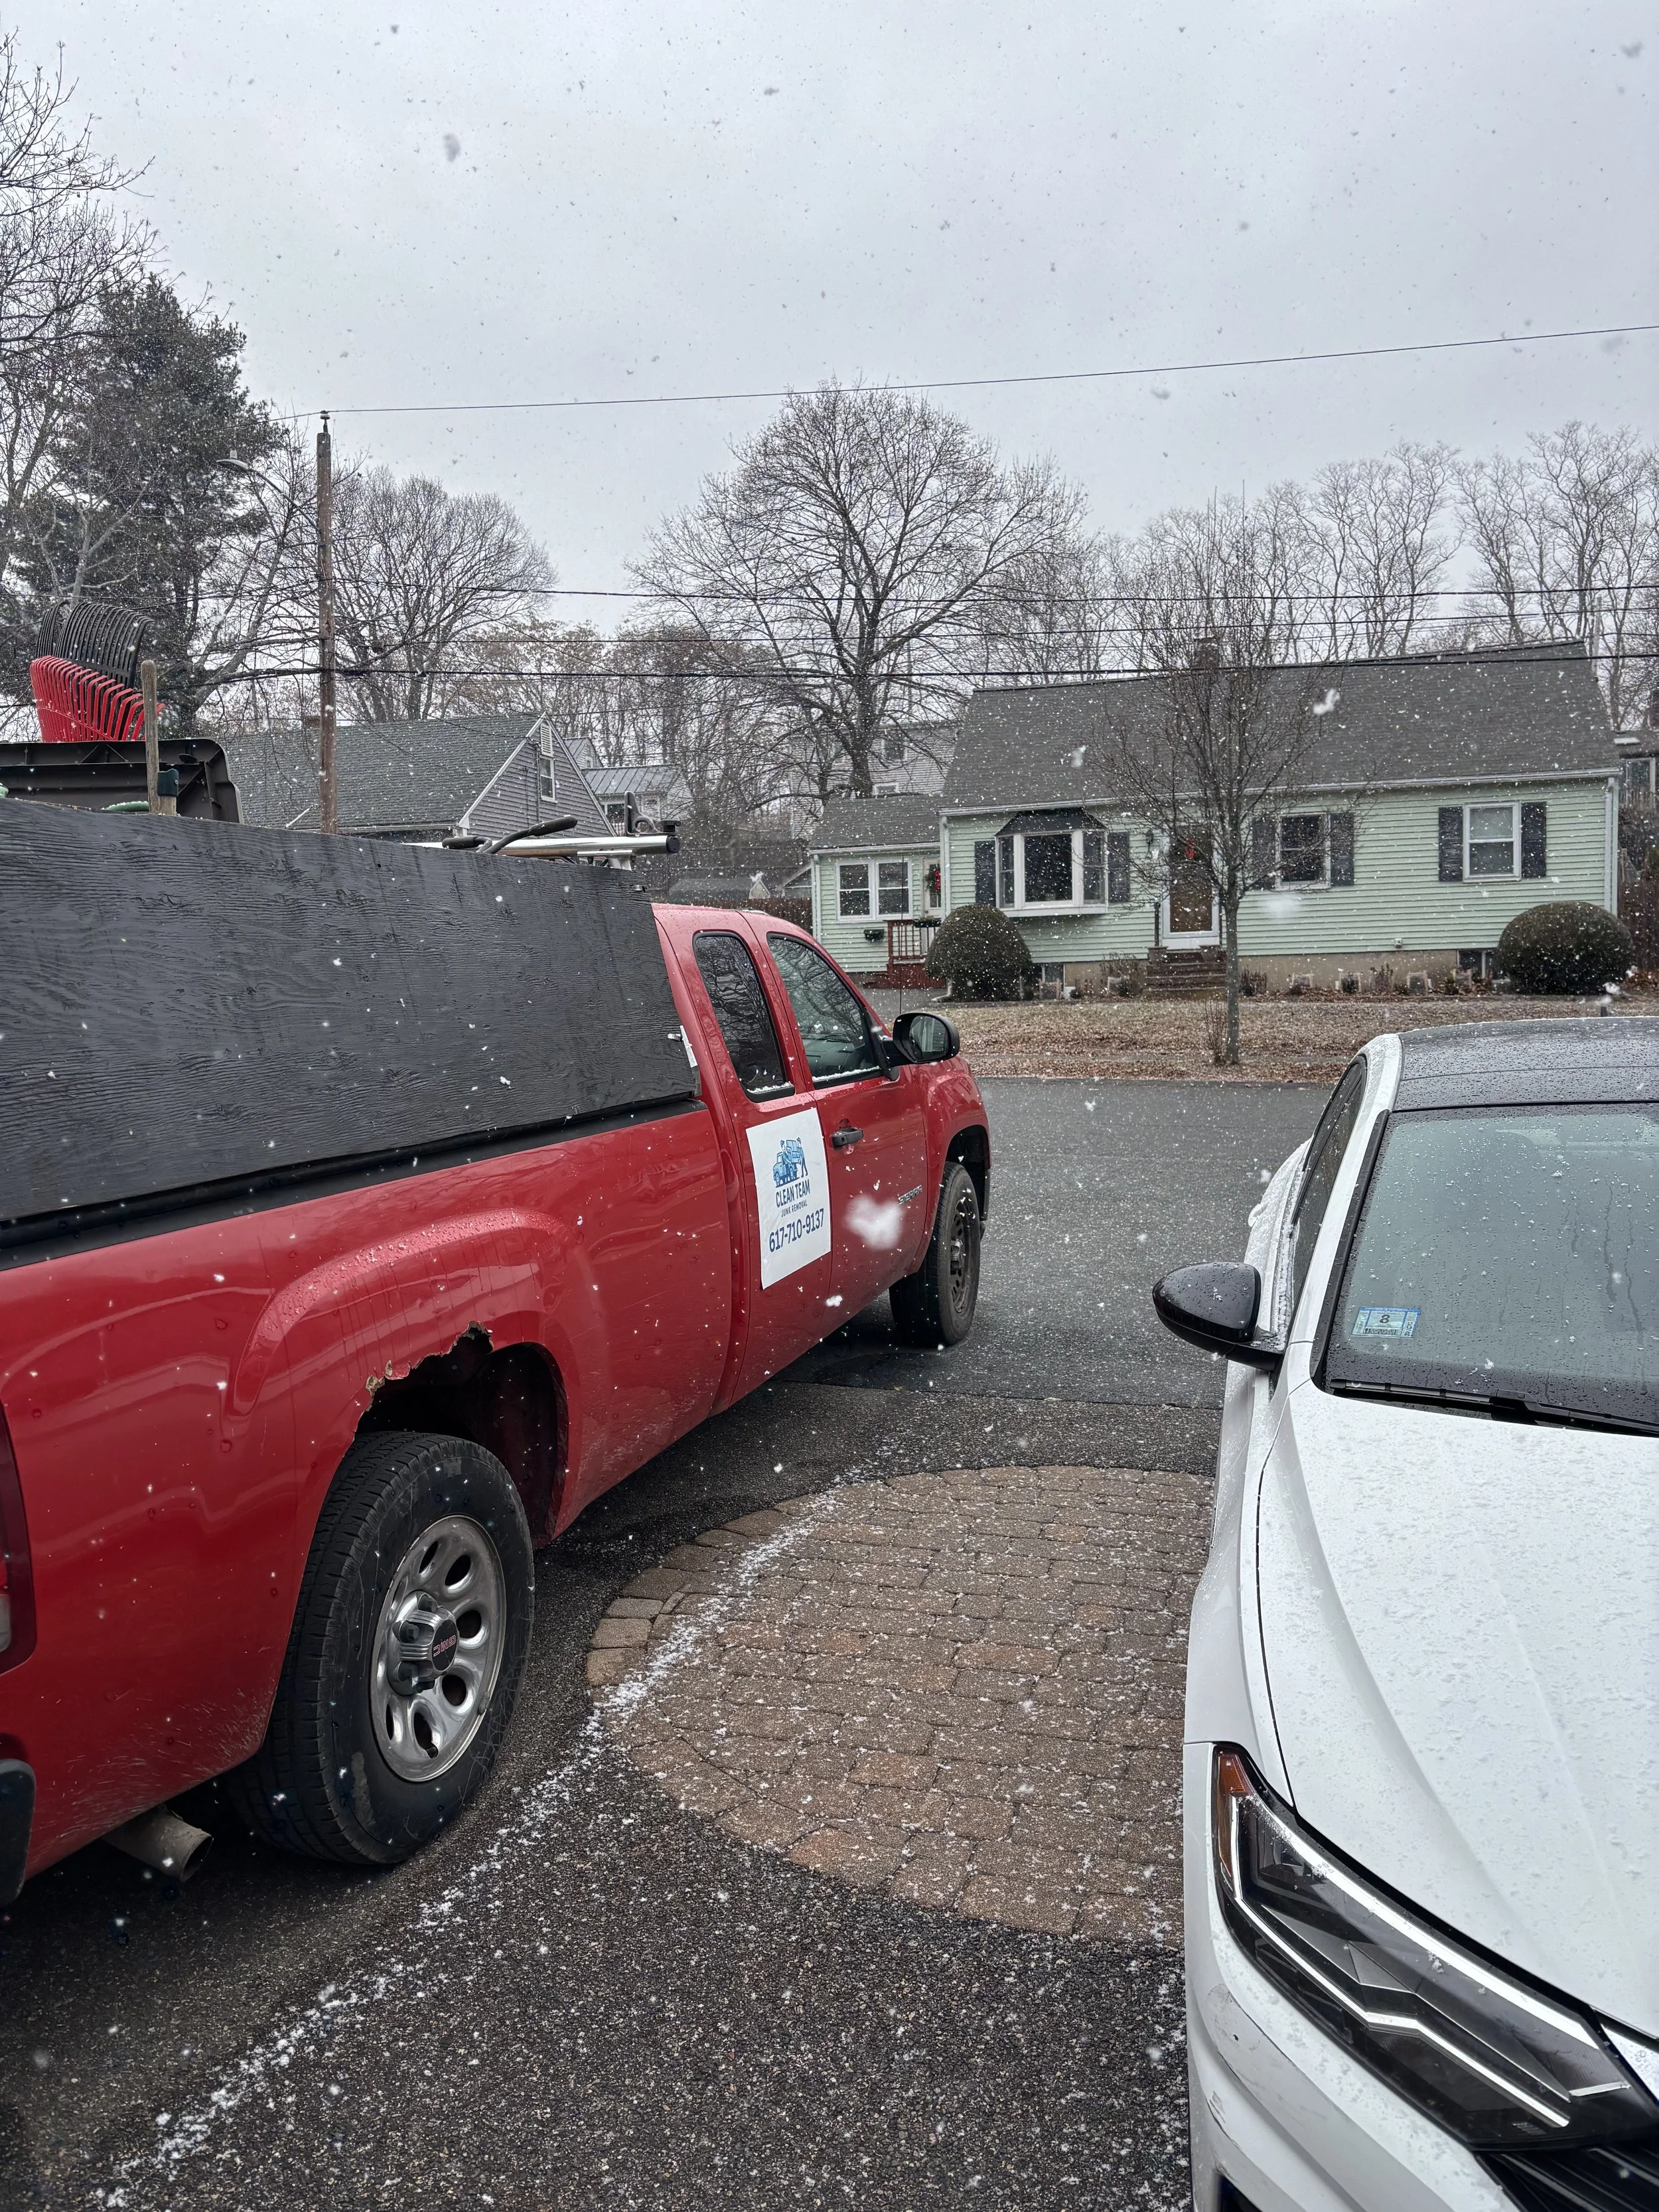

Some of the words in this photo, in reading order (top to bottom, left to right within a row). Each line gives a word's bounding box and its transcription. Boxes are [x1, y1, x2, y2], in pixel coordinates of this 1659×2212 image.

[776, 1185, 794, 1208] CLEAN
[795, 1179, 810, 1199] TEAM
[781, 1206, 791, 1217] JUNK
[791, 1199, 808, 1213] REMOVAL
[769, 1208, 824, 1252] 617-710-9137
[1380, 1314, 1390, 1323] 8
[433, 1635, 456, 1657] GMC
